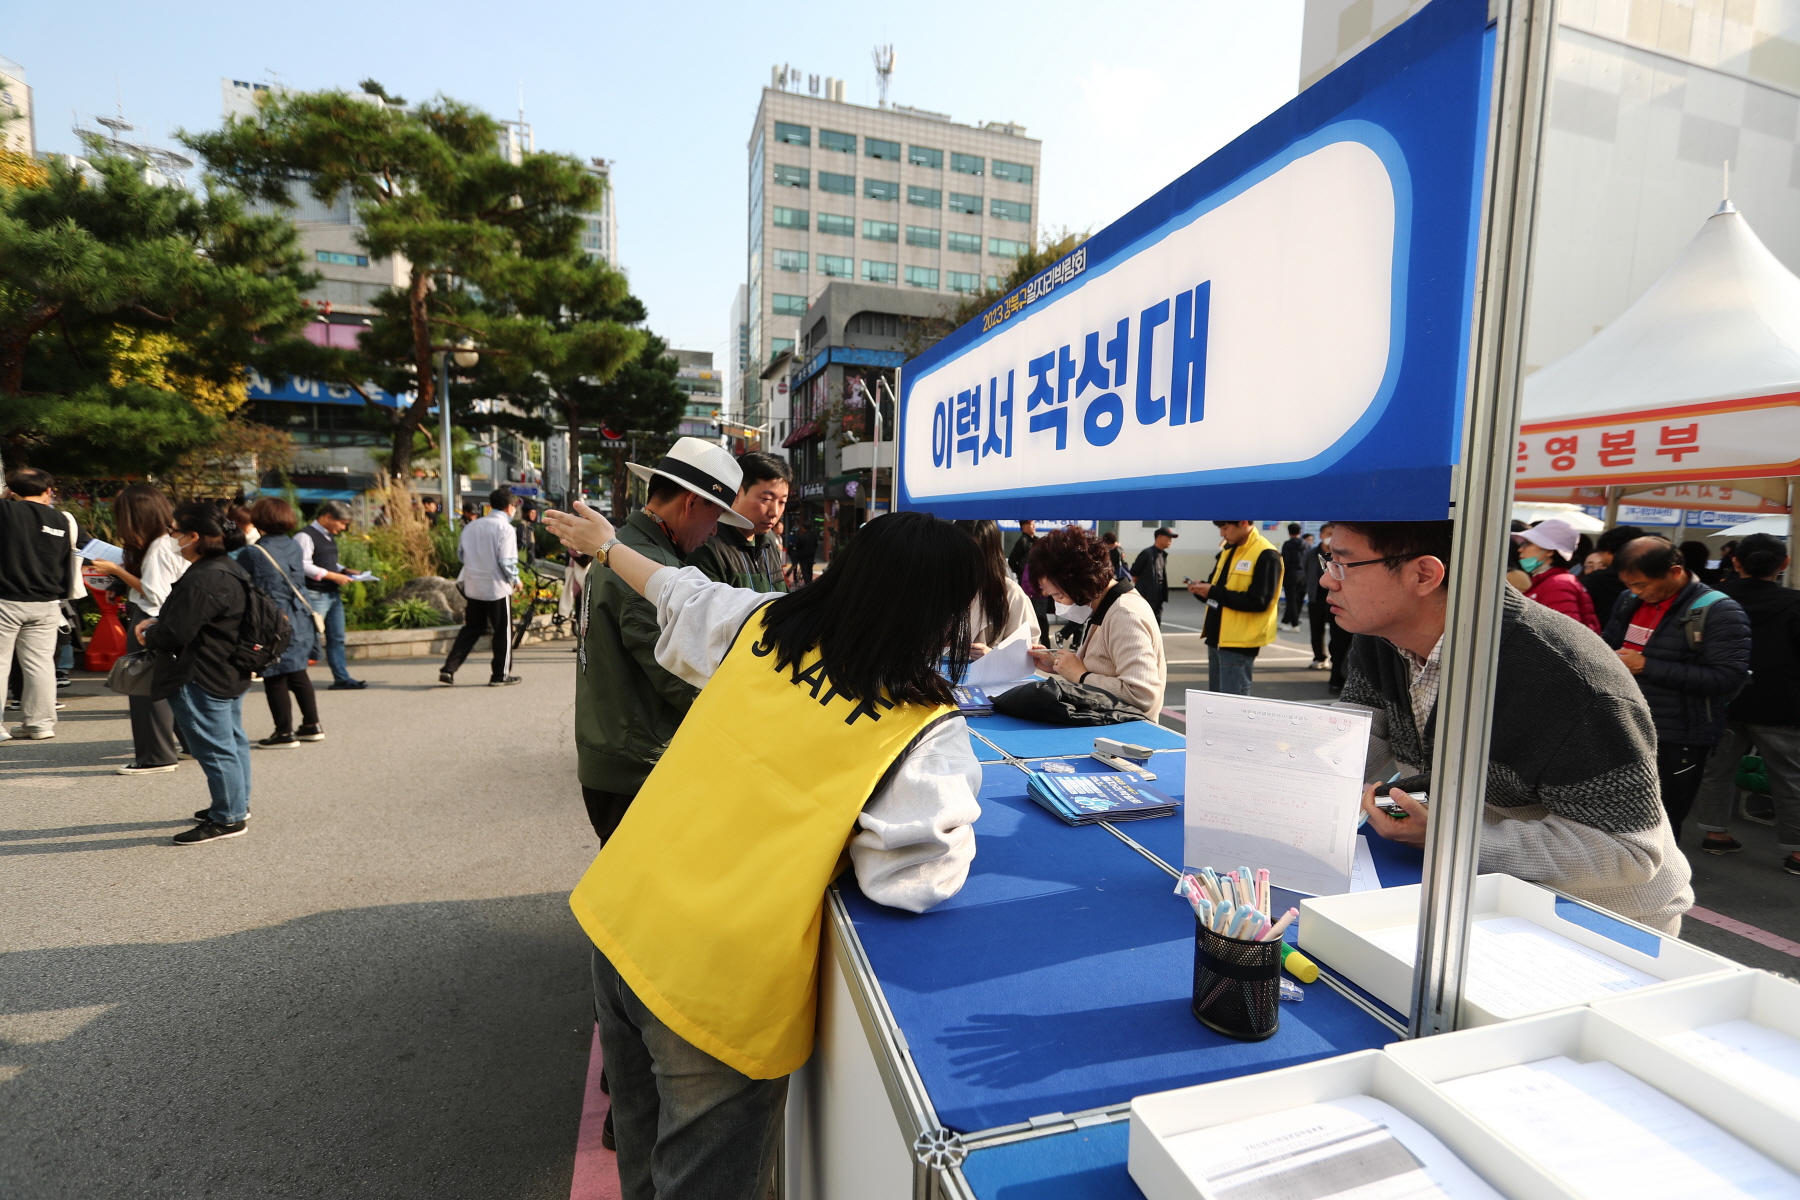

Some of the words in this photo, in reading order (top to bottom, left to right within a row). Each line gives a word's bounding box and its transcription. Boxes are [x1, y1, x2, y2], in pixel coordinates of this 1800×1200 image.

[983, 305, 1004, 332] 2023
[932, 368, 1015, 469] 이력서
[1026, 279, 1211, 450] 작성대
